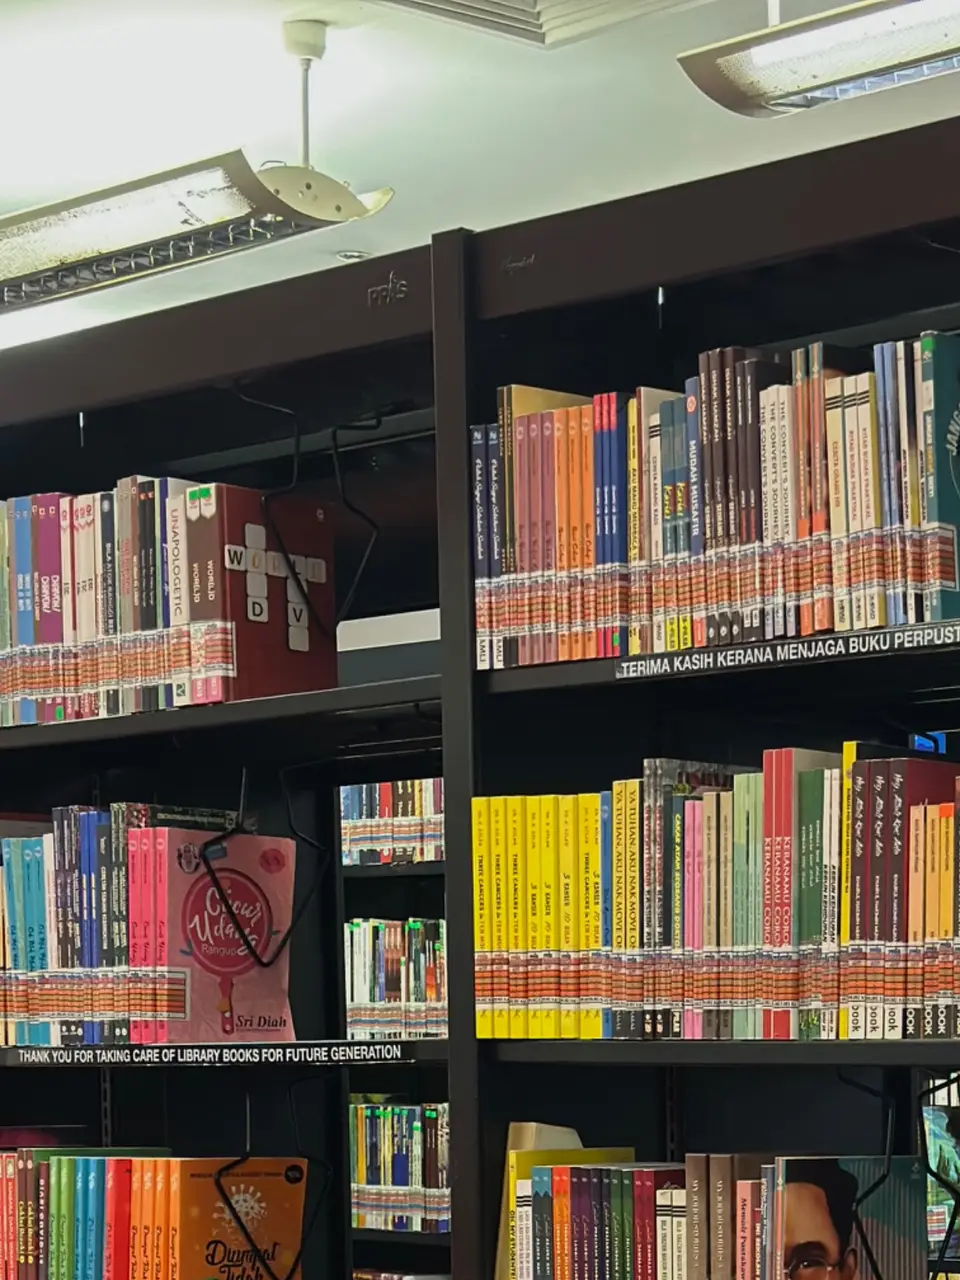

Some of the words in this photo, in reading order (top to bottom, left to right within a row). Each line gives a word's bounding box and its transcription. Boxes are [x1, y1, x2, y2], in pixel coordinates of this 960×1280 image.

[688, 440, 698, 483] MUDAH
[691, 486, 699, 536] MUSAFIR
[171, 508, 182, 616] UNAPOLOGETIC
[622, 658, 670, 678] TERIMA
[674, 653, 713, 673] KASIH
[717, 650, 773, 668] KERANA
[776, 639, 844, 661] MENJAGA
[849, 634, 890, 653] BUKU
[615, 852, 623, 873] AKU
[629, 852, 637, 873] AKU
[783, 836, 791, 902] KERANAMU
[615, 875, 623, 899] NAK
[629, 875, 637, 899] NAK
[615, 901, 623, 934] MOVE
[629, 901, 637, 934] MOVE
[236, 1015, 254, 1028] Sri
[19, 1049, 50, 1062] THANK
[52, 1049, 71, 1063] YOU
[74, 1049, 93, 1063] FOR
[95, 1049, 130, 1062] TAKING
[133, 1049, 159, 1062] CARE
[162, 1049, 175, 1062] OF
[178, 1048, 219, 1062] LIBRARY
[223, 1048, 259, 1062] BOOKS
[262, 1048, 283, 1062] FOR
[286, 1047, 328, 1061] FUTURE
[331, 1044, 401, 1060] GENERATION
[740, 1197, 748, 1233] Memoir
